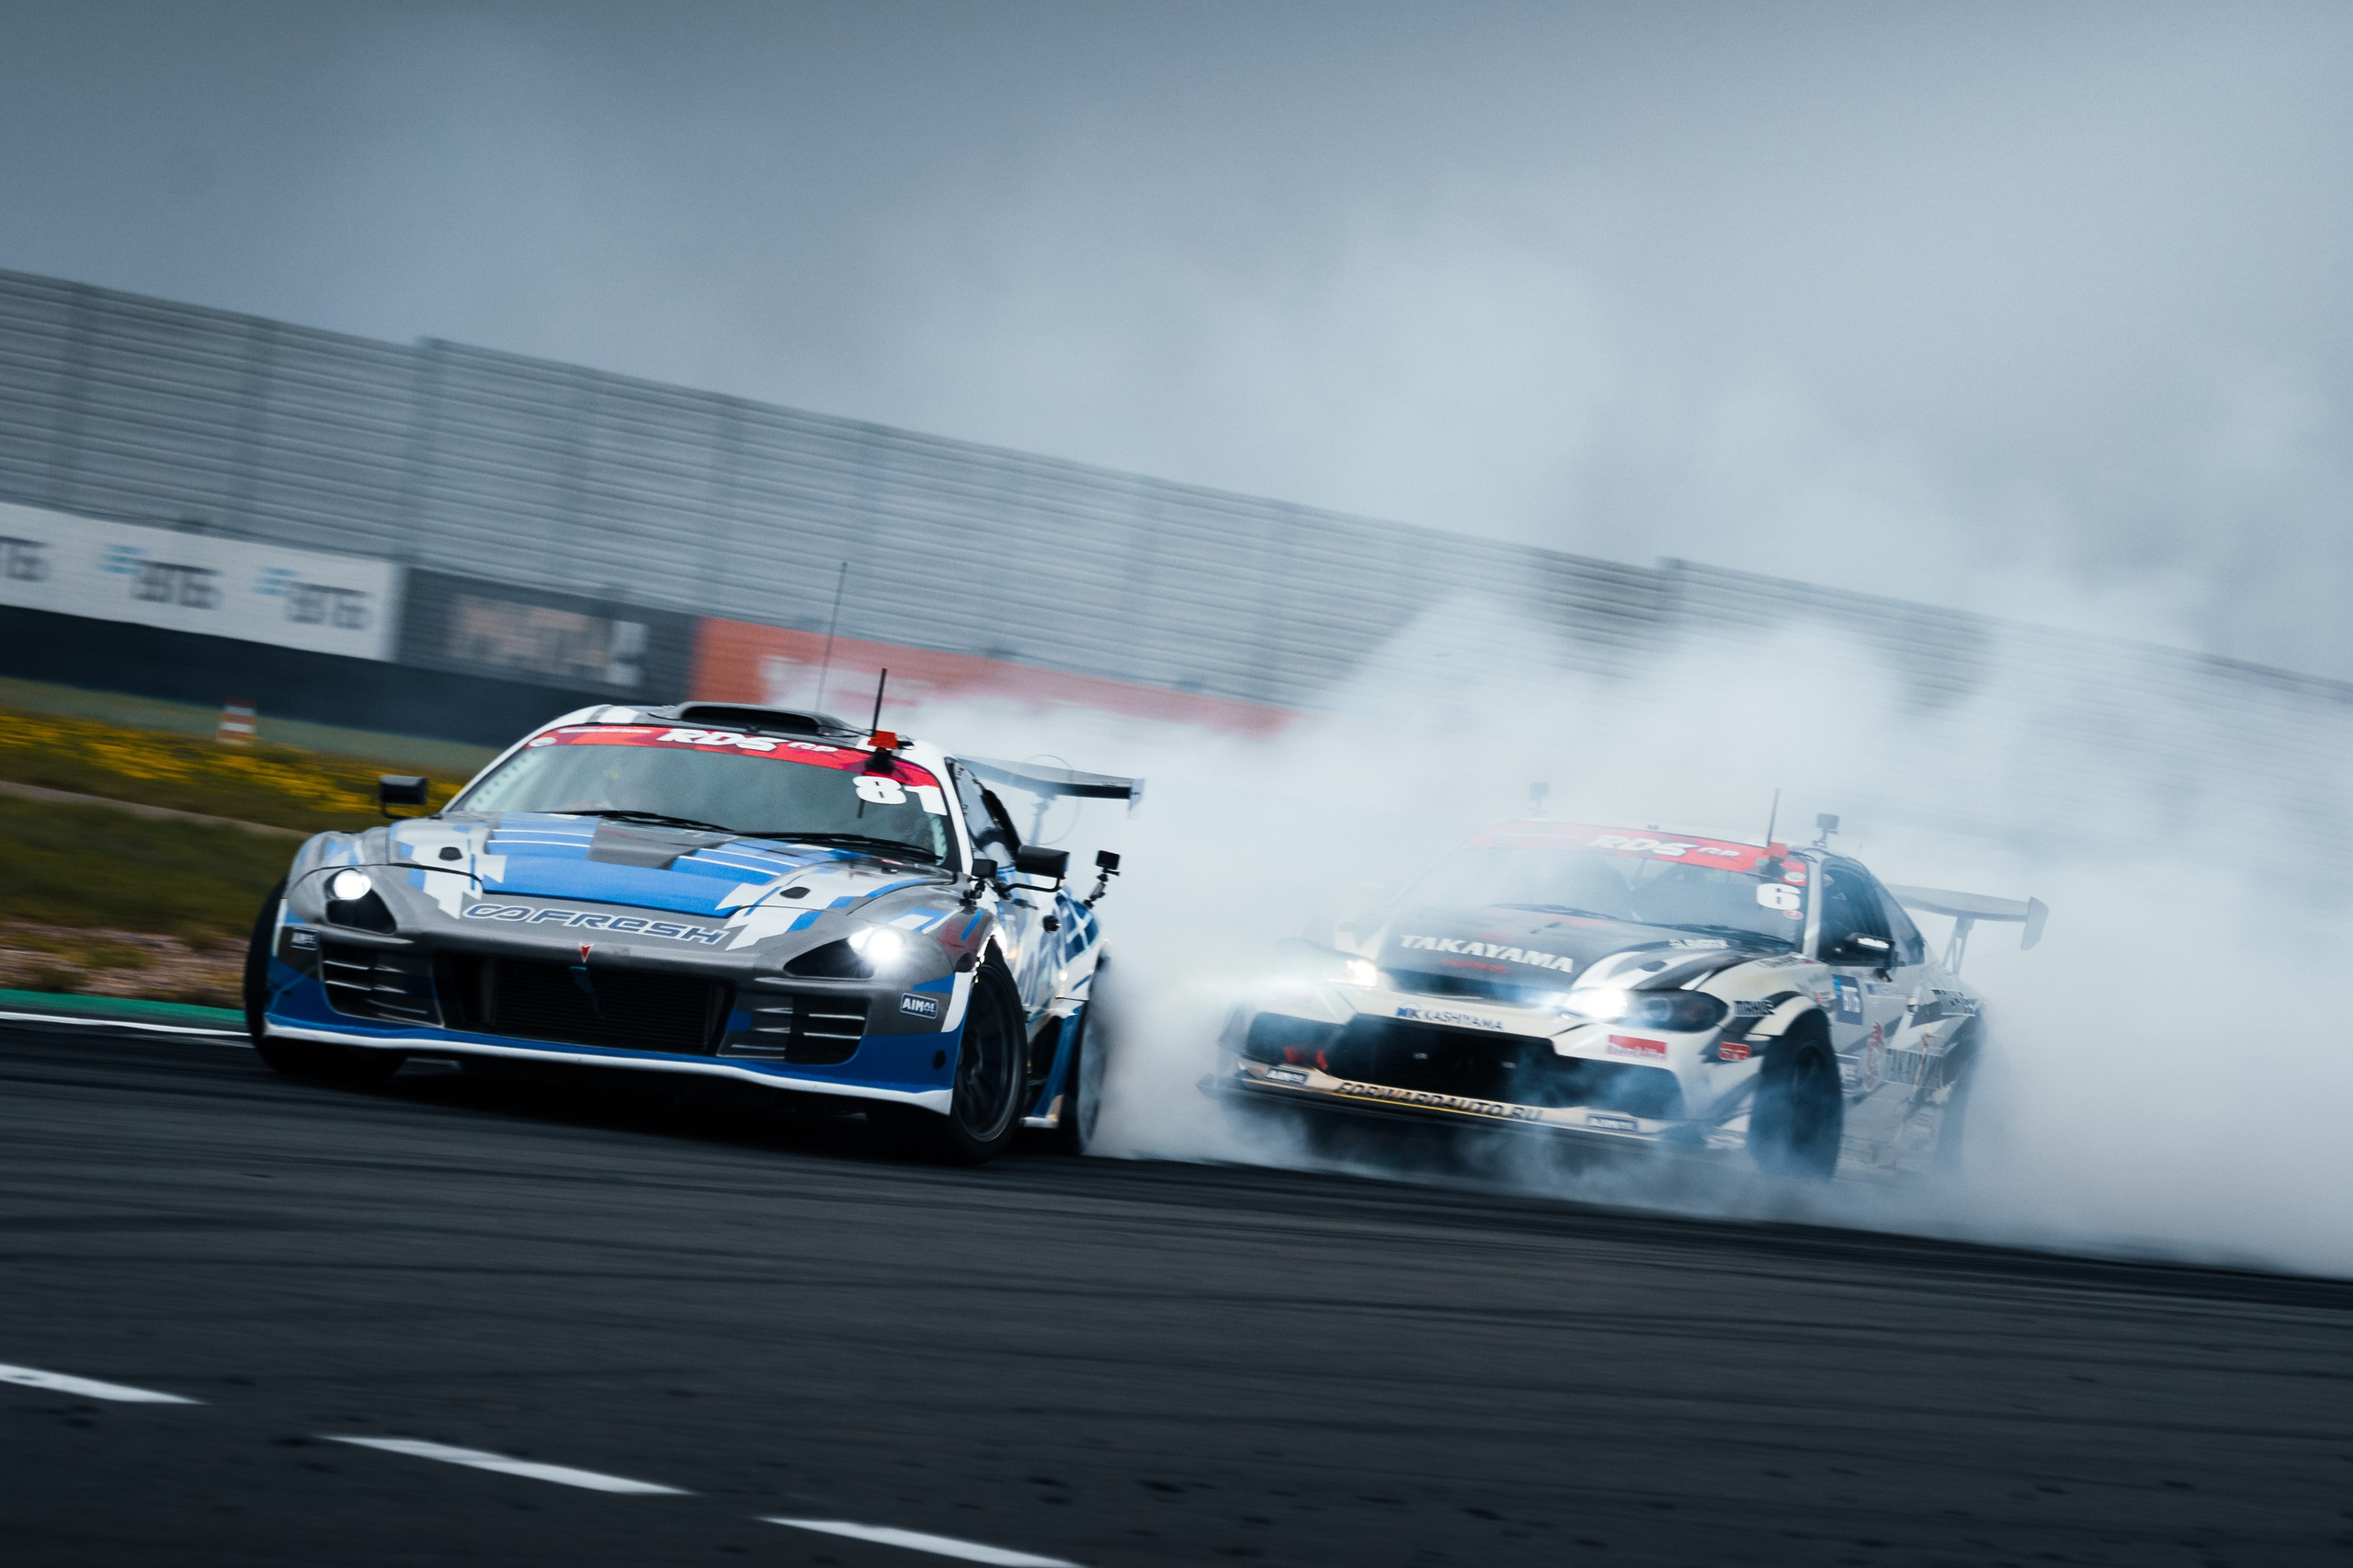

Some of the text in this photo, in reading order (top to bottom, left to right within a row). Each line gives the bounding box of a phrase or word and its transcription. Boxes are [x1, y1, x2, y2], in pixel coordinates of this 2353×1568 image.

[656, 729, 839, 753] RDS GP
[852, 776, 949, 816] 81
[1586, 835, 1699, 858] RDS
[1756, 882, 1802, 911] 6
[1400, 934, 1574, 974] TAKAYAMA
